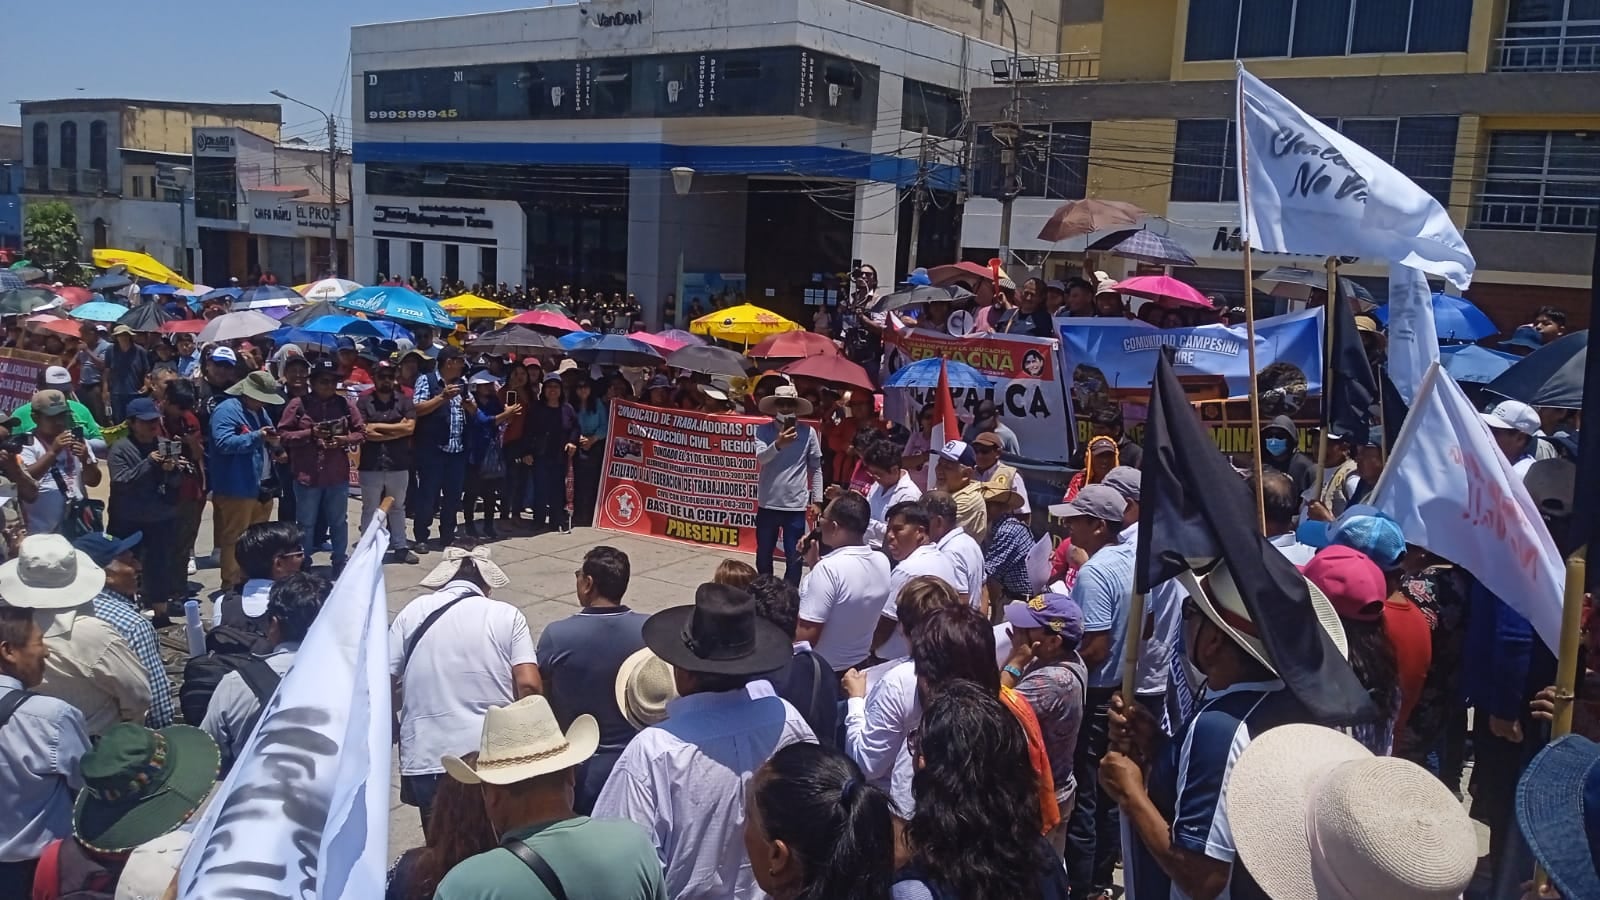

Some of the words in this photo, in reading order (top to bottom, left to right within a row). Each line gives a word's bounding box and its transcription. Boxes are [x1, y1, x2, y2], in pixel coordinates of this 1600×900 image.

[369, 109, 458, 119] 999399945
[1287, 162, 1332, 198] No
[309, 206, 341, 221] PROE
[1123, 335, 1176, 351] COMUNIDAD
[1179, 335, 1239, 354] CAMPESINA
[618, 405, 659, 423] SINDICATO
[660, 414, 671, 426] DE
[672, 415, 742, 436] TRABAJADORAS
[628, 423, 688, 446] CONSTRUCCIÓN
[690, 435, 711, 450] CIVIL
[721, 437, 757, 454] REGIÓN
[686, 450, 693, 462] 31
[694, 451, 702, 463] DE
[703, 452, 724, 467] ENERO
[725, 455, 737, 468] DEL
[738, 457, 756, 469] 2007
[609, 463, 637, 480] AFILIADO
[643, 470, 650, 482] LA
[683, 477, 692, 491] DE
[693, 479, 747, 498] TRABAJADORES
[646, 498, 670, 514] BASE
[670, 504, 682, 517] DE
[683, 506, 695, 520] LA
[697, 509, 727, 524] CGTP
[666, 519, 738, 546] PRESENTE
